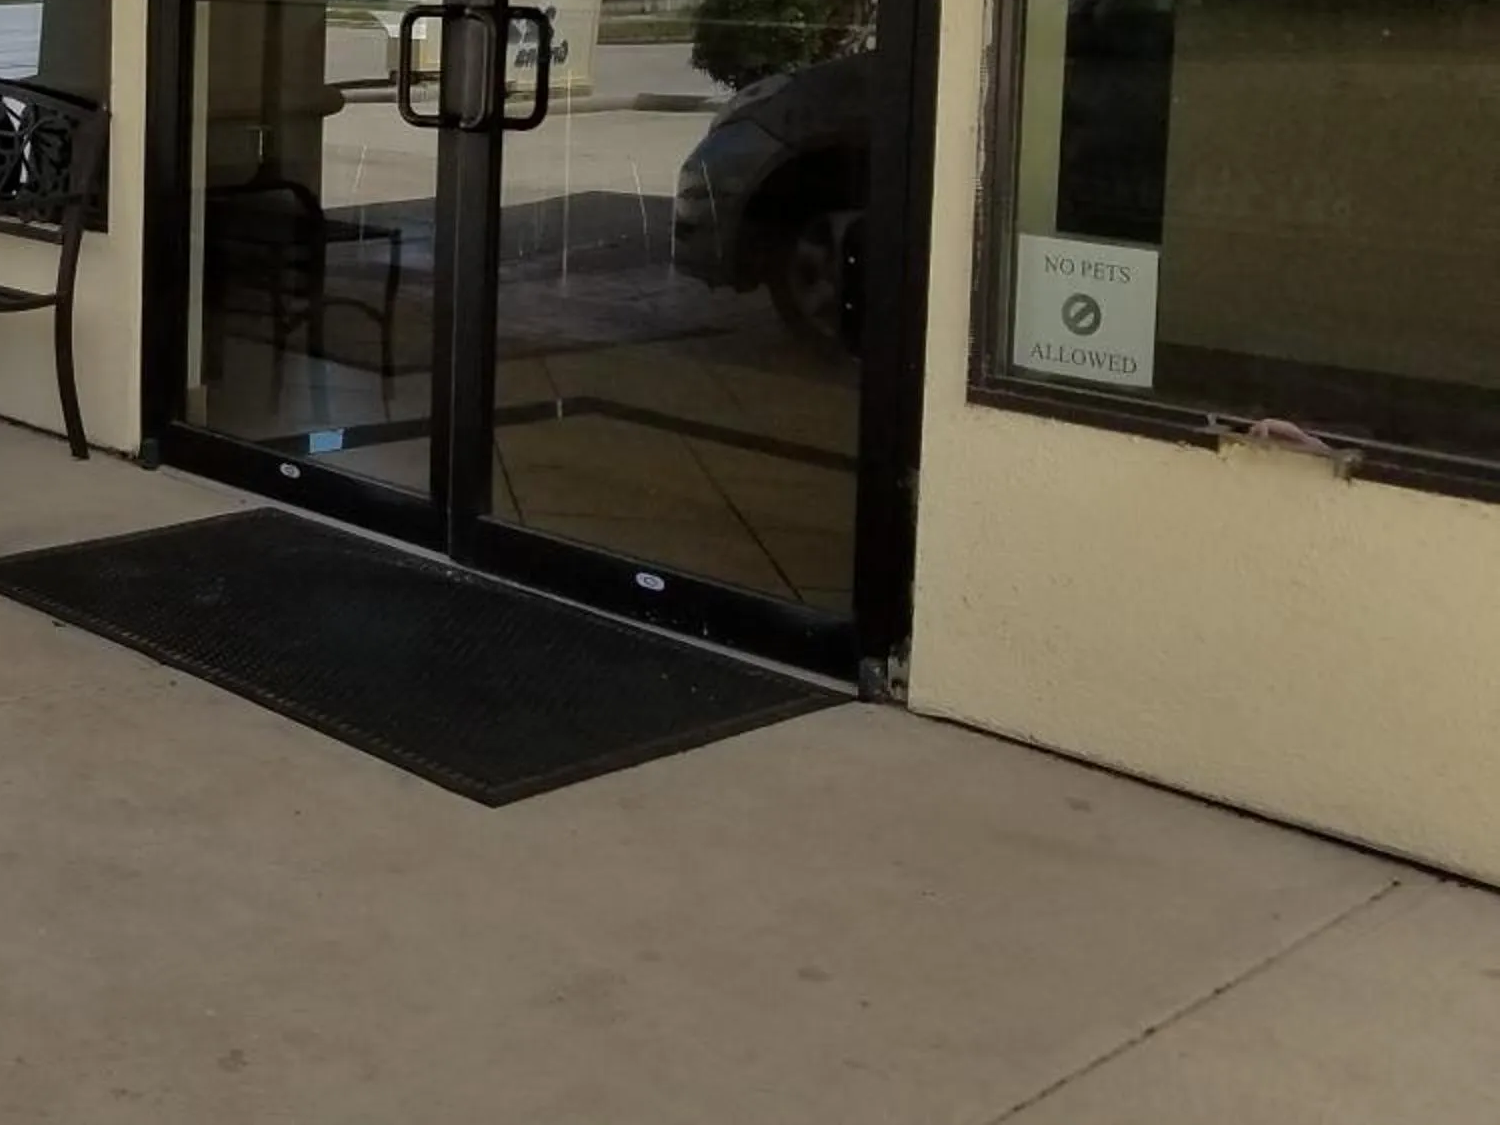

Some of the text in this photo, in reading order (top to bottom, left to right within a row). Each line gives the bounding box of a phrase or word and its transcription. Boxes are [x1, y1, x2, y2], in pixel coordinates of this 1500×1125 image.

[1044, 254, 1132, 284] NO PETS
[1030, 343, 1138, 375] ALLOWED
